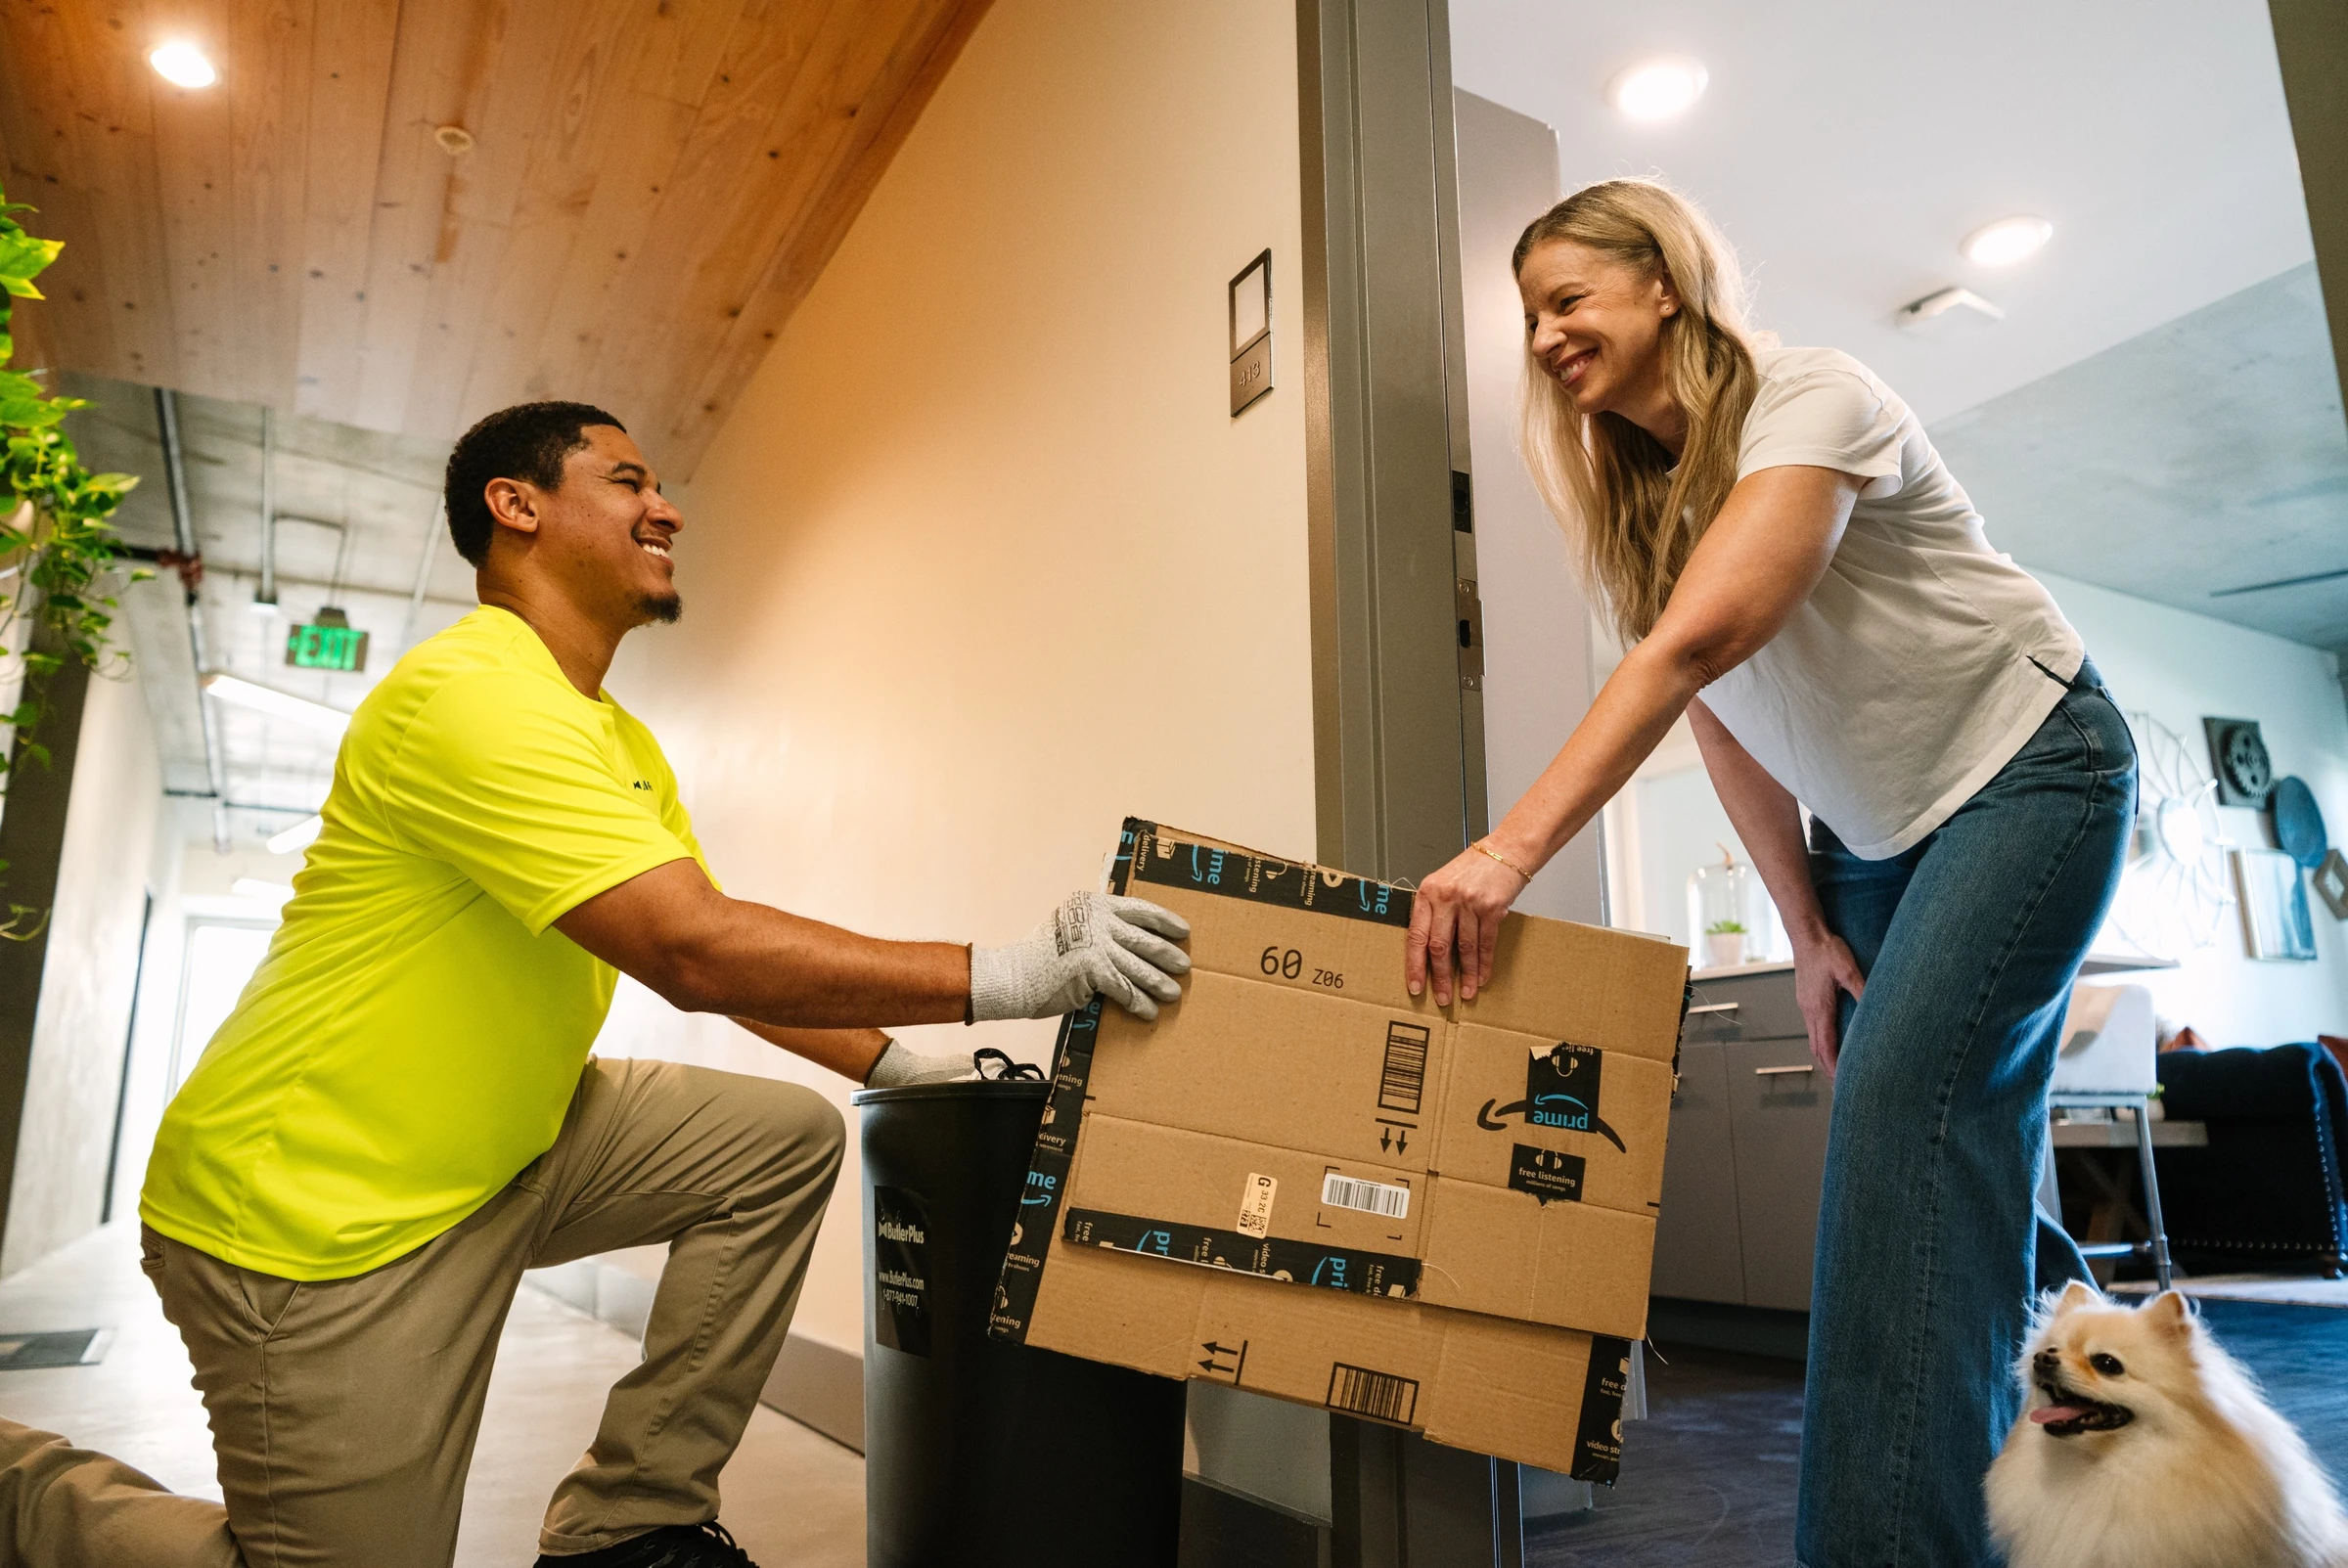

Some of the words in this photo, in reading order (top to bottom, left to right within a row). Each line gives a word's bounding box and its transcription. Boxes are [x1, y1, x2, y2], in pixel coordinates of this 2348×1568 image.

[1239, 360, 1261, 387] 413
[294, 624, 364, 672] EXIT
[1136, 834, 1151, 872] delivery
[1260, 946, 1303, 980] 60
[1532, 1110, 1590, 1130] prime
[1258, 1177, 1272, 1187] G
[1518, 1167, 1537, 1179] free
[1538, 1171, 1576, 1187] listening
[887, 1221, 925, 1244] ButlerPlus
[1082, 1221, 1094, 1242] free
[1201, 1236, 1212, 1258] free
[1259, 1242, 1271, 1268] video
[1374, 1265, 1385, 1284] free
[1601, 1377, 1619, 1389] free
[1586, 1439, 1608, 1453] video
